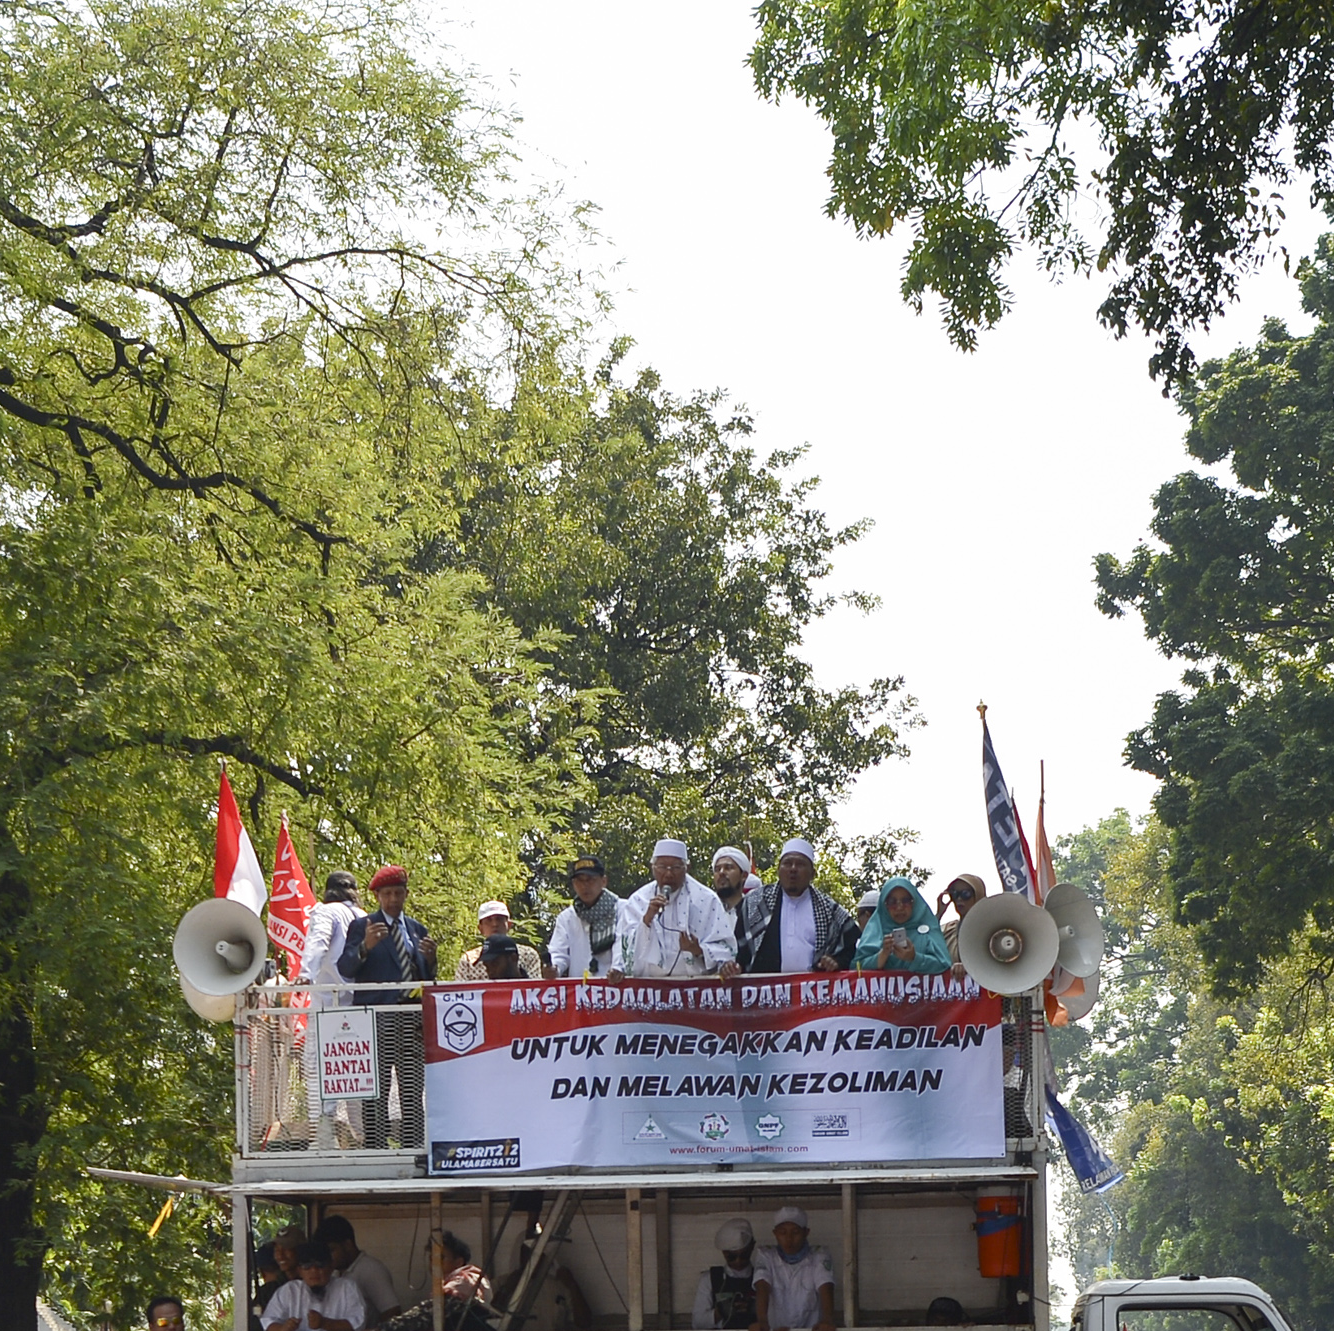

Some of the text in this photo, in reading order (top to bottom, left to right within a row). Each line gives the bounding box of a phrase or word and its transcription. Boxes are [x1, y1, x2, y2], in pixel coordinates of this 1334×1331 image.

[510, 974, 980, 1014] AKSI KEDAULATAN DAN KEMANUSIAAN
[323, 1041, 370, 1057] JANGAN
[511, 1025, 986, 1064] UNTUK MENEGAKKAN KEADILAN
[324, 1059, 371, 1075] BANTAI
[551, 1069, 943, 1101] DAN MELAWAN KEZOLIMAN
[669, 1145, 809, 1154] www.forum-umat-islam.com
